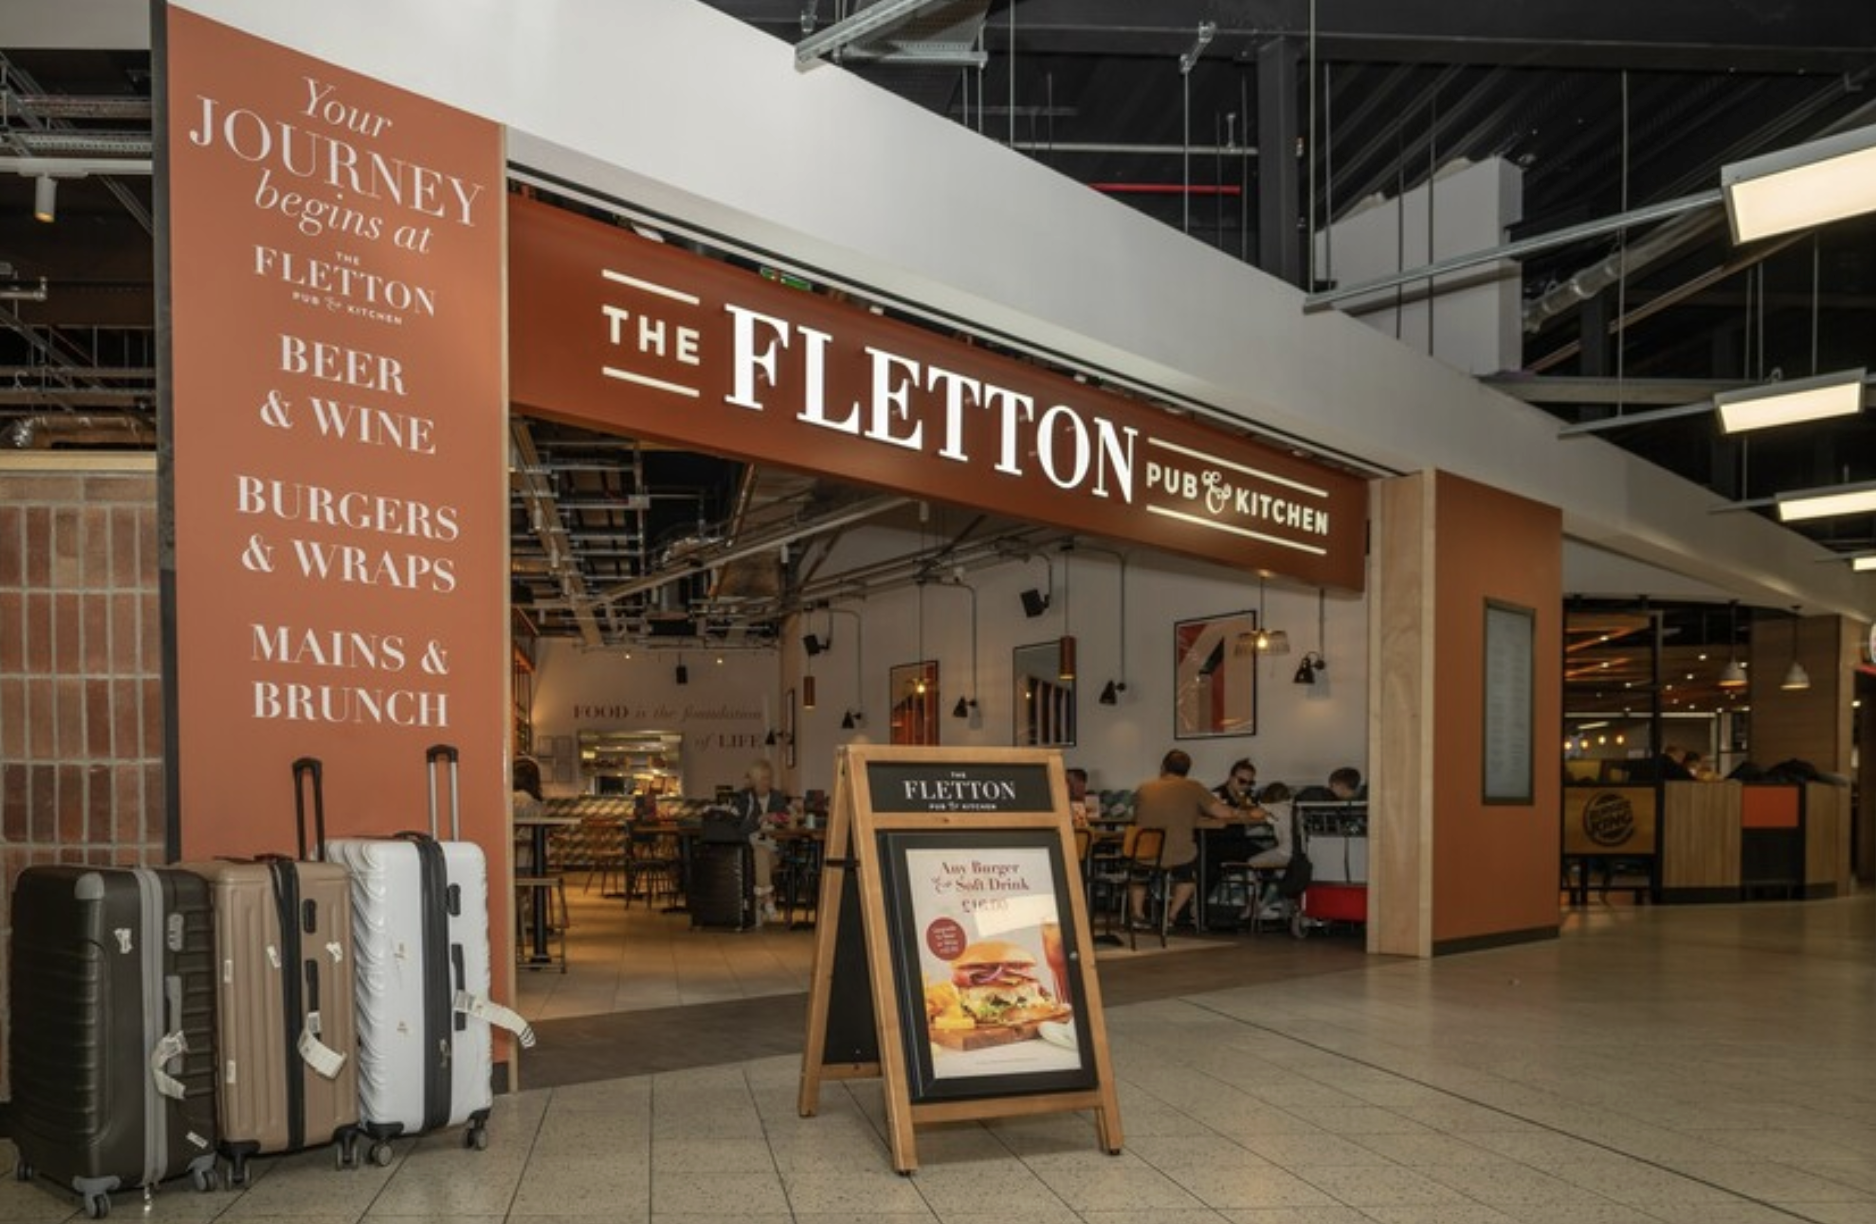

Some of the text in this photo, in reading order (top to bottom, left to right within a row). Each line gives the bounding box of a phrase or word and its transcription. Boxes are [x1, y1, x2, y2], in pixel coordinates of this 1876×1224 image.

[303, 76, 393, 137] Your
[189, 94, 485, 228] JOURNEY
[255, 168, 433, 254] begins at
[253, 245, 436, 317] FLETTON
[336, 251, 361, 267] THE
[293, 291, 402, 325] PUB & KITCHEN
[278, 333, 407, 396] BEER
[260, 389, 436, 455] & WINE
[602, 303, 1330, 536] THE FLETTON PUB & KITCHEN
[234, 474, 460, 542] BURGERS
[241, 533, 456, 593] & WRAPS
[251, 623, 449, 675] MAINS &
[252, 680, 449, 727] BRUNCH
[574, 704, 629, 720] FOOD
[718, 734, 762, 748] LIFE
[903, 779, 1016, 800] FLETTON
[942, 860, 1020, 880] Any Burger
[955, 877, 984, 892] Soft
[989, 876, 1030, 891] Drink
